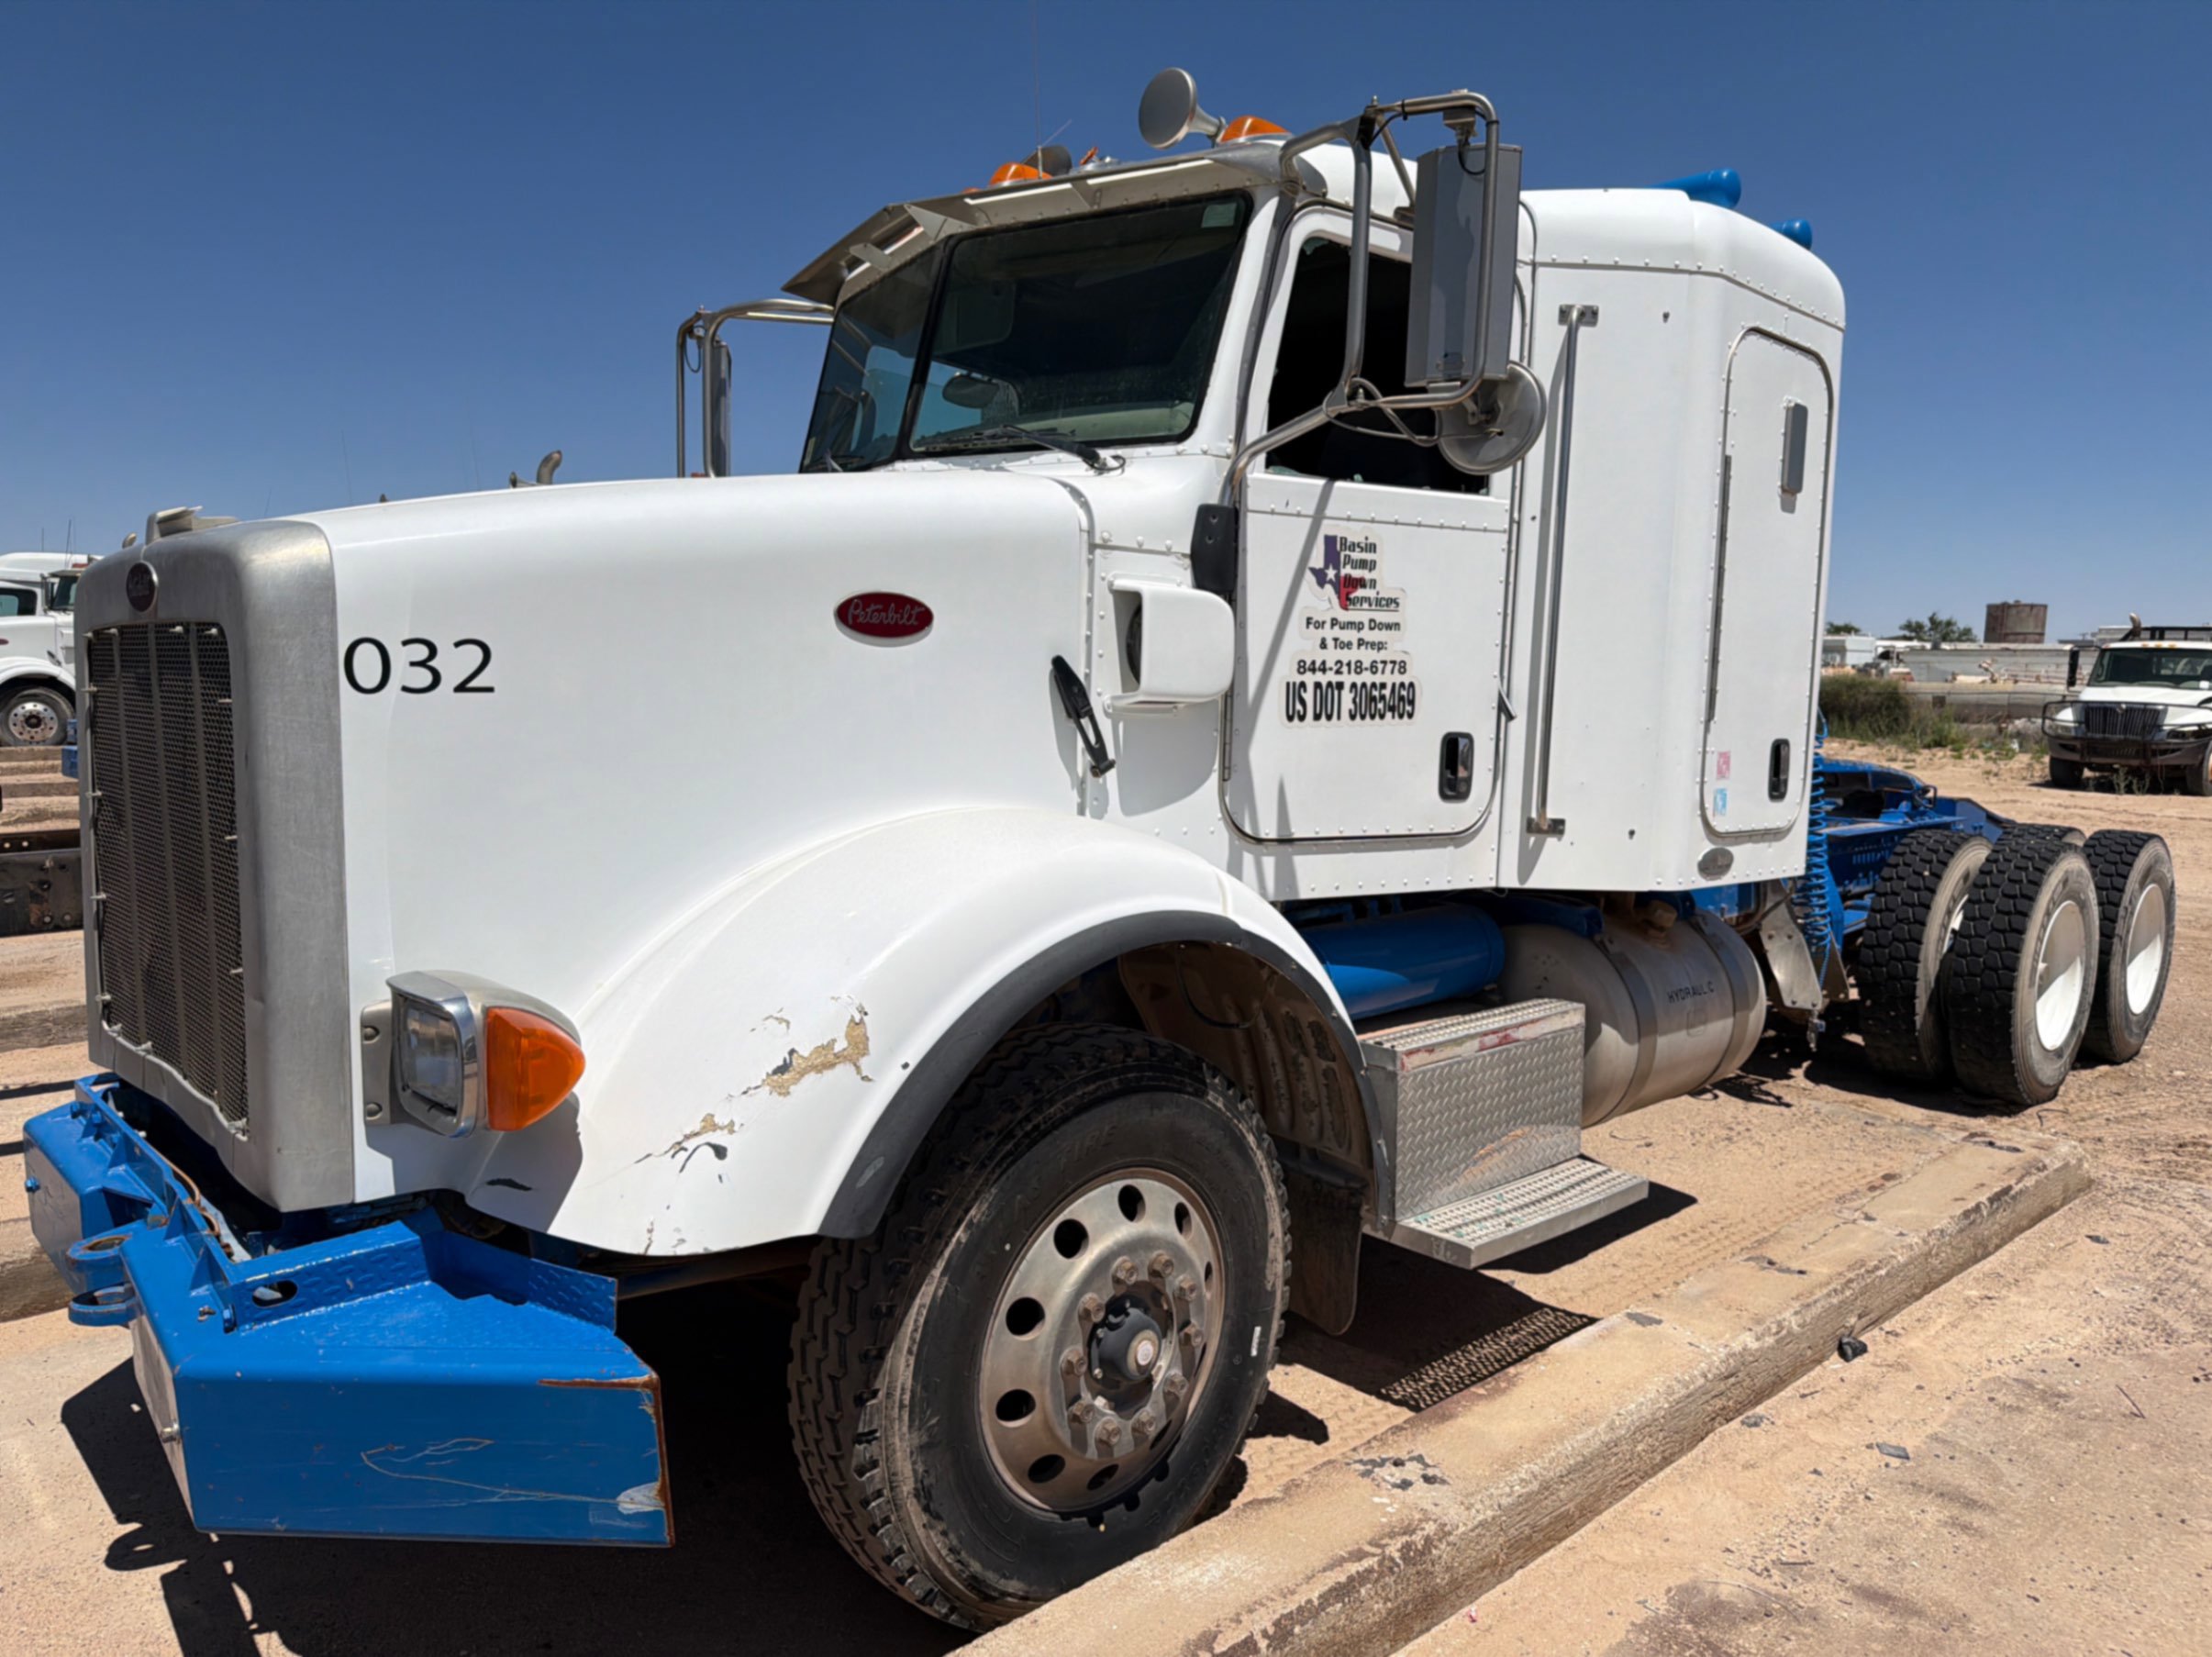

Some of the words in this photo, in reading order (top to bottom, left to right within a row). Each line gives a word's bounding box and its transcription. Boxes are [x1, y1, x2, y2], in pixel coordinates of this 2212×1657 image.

[1339, 536, 1377, 554] Basin
[1342, 553, 1377, 573] Pump
[1343, 573, 1377, 590] Down
[1346, 591, 1400, 608] Services
[848, 599, 926, 625] Peterbilt
[1306, 617, 1327, 629] For
[1330, 617, 1364, 633] Pump
[1368, 618, 1400, 631] Down
[1319, 637, 1328, 650] &
[1332, 638, 1353, 651] Toe
[1357, 638, 1387, 653] Prep:
[343, 637, 495, 695] 032
[1296, 659, 1406, 675] 844-218-6778
[1285, 681, 1307, 722] US
[1313, 681, 1345, 722] DOT
[1349, 681, 1416, 722] 3065469
